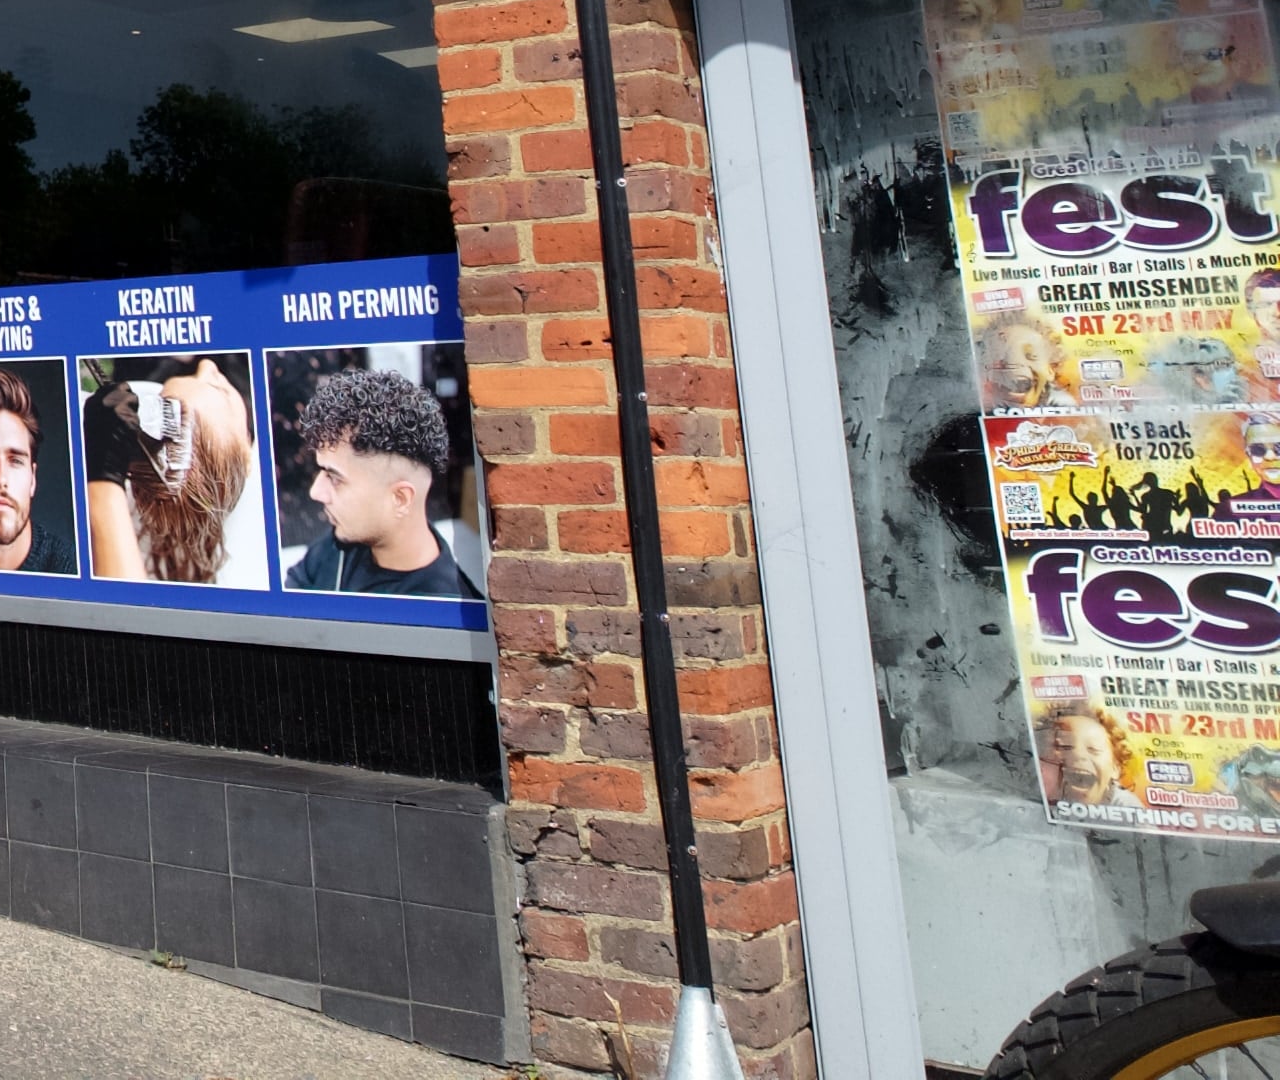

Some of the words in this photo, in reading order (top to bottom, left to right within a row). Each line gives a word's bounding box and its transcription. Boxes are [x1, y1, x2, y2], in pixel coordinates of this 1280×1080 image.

[969, 156, 1276, 256] fest
[972, 268, 999, 282] Live
[1001, 266, 1042, 280] Music
[1051, 262, 1098, 277] Funfair
[1109, 261, 1133, 274] Bar
[1144, 258, 1186, 273] Stalls
[1197, 257, 1207, 269] &
[1210, 253, 1253, 268] Much
[1255, 251, 1280, 267] Mo
[118, 285, 196, 316] KERATIN
[1039, 282, 1103, 303] GREAT
[1109, 275, 1240, 300] MISSENDEN
[28, 296, 41, 321] &
[282, 292, 333, 323] HAIR
[339, 284, 439, 320] PERMING
[1074, 301, 1111, 313] FIELDS
[1116, 300, 1143, 311] LINK
[105, 316, 212, 347] TREATMENT
[1062, 315, 1106, 337] SAT
[1113, 311, 1173, 334] 23rd
[1110, 422, 1140, 440] It's
[1146, 420, 1192, 439] Back
[1117, 442, 1141, 460] for
[1148, 441, 1195, 461] 2026
[1194, 520, 1237, 536] Elton
[1242, 520, 1280, 537] John
[1094, 547, 1149, 562] Great
[1154, 548, 1270, 563] Missenden
[1027, 550, 1280, 653] fes
[1061, 654, 1103, 668] Music
[1115, 655, 1165, 671] Funfair
[1176, 658, 1202, 672] Bar
[1214, 659, 1257, 675] Stalls
[1101, 675, 1171, 698] GREAT
[1177, 680, 1280, 703] MISSEND
[1140, 698, 1177, 710] FIELDS
[1184, 699, 1212, 712] LINK
[1215, 701, 1249, 714] ROAD
[1255, 703, 1280, 715] HP1
[1127, 711, 1172, 735] SAT
[1183, 713, 1248, 739] 23rd
[1254, 717, 1280, 741] MA
[1151, 737, 1185, 748] Open
[1151, 763, 1190, 775] FREE
[1149, 790, 1180, 805] Dino
[1182, 792, 1237, 808] Invasion
[1057, 801, 1200, 829] SOMETHING
[1204, 813, 1256, 833] FOR
